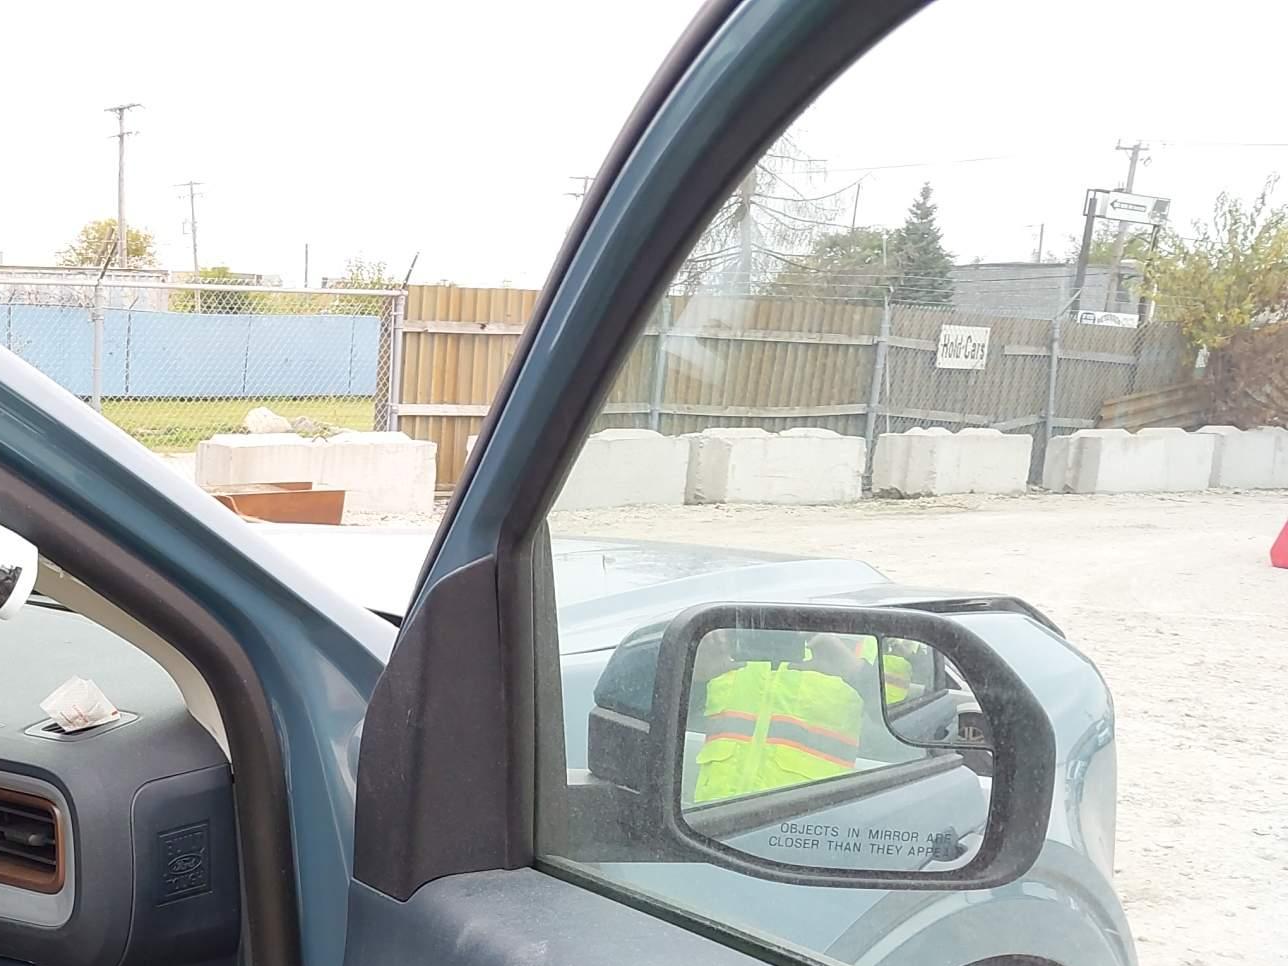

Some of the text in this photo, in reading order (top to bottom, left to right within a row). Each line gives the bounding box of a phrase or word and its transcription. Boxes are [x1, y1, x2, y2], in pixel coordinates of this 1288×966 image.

[780, 822, 952, 843] OBJECTS IN MIRROR ARE
[768, 836, 952, 858] CLOSER THAN THEY APPE
